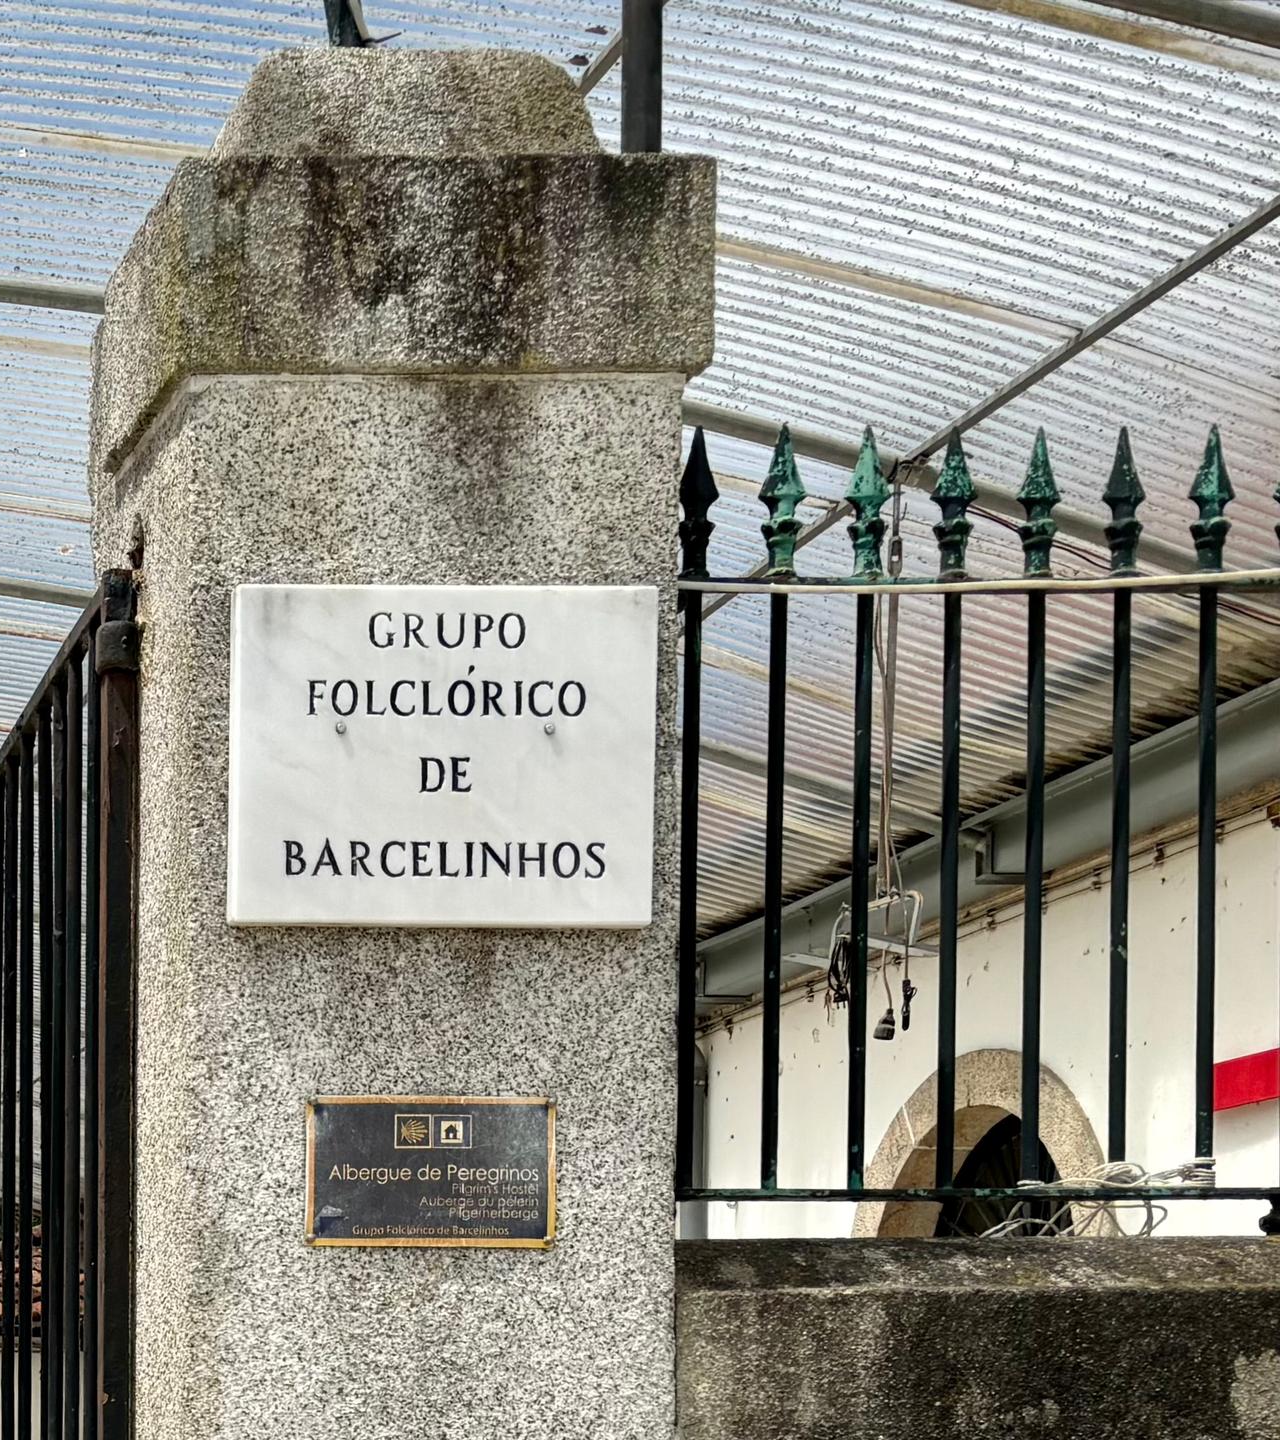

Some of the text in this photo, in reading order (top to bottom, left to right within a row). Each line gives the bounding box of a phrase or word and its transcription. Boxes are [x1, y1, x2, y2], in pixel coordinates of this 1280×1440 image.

[368, 611, 526, 649] GRUPO
[306, 663, 587, 717] FOLCLÓRICO
[418, 756, 473, 793] DE
[282, 837, 607, 879] BARCELINHOS
[328, 1163, 539, 1185] Albergue de Peregrinos
[419, 1196, 475, 1209] Auberge
[477, 1196, 494, 1206] du
[502, 1183, 539, 1195] Hostel
[352, 1225, 384, 1237] Grupo
[436, 1225, 450, 1236] de
[452, 1225, 510, 1237] Barcelinhos
